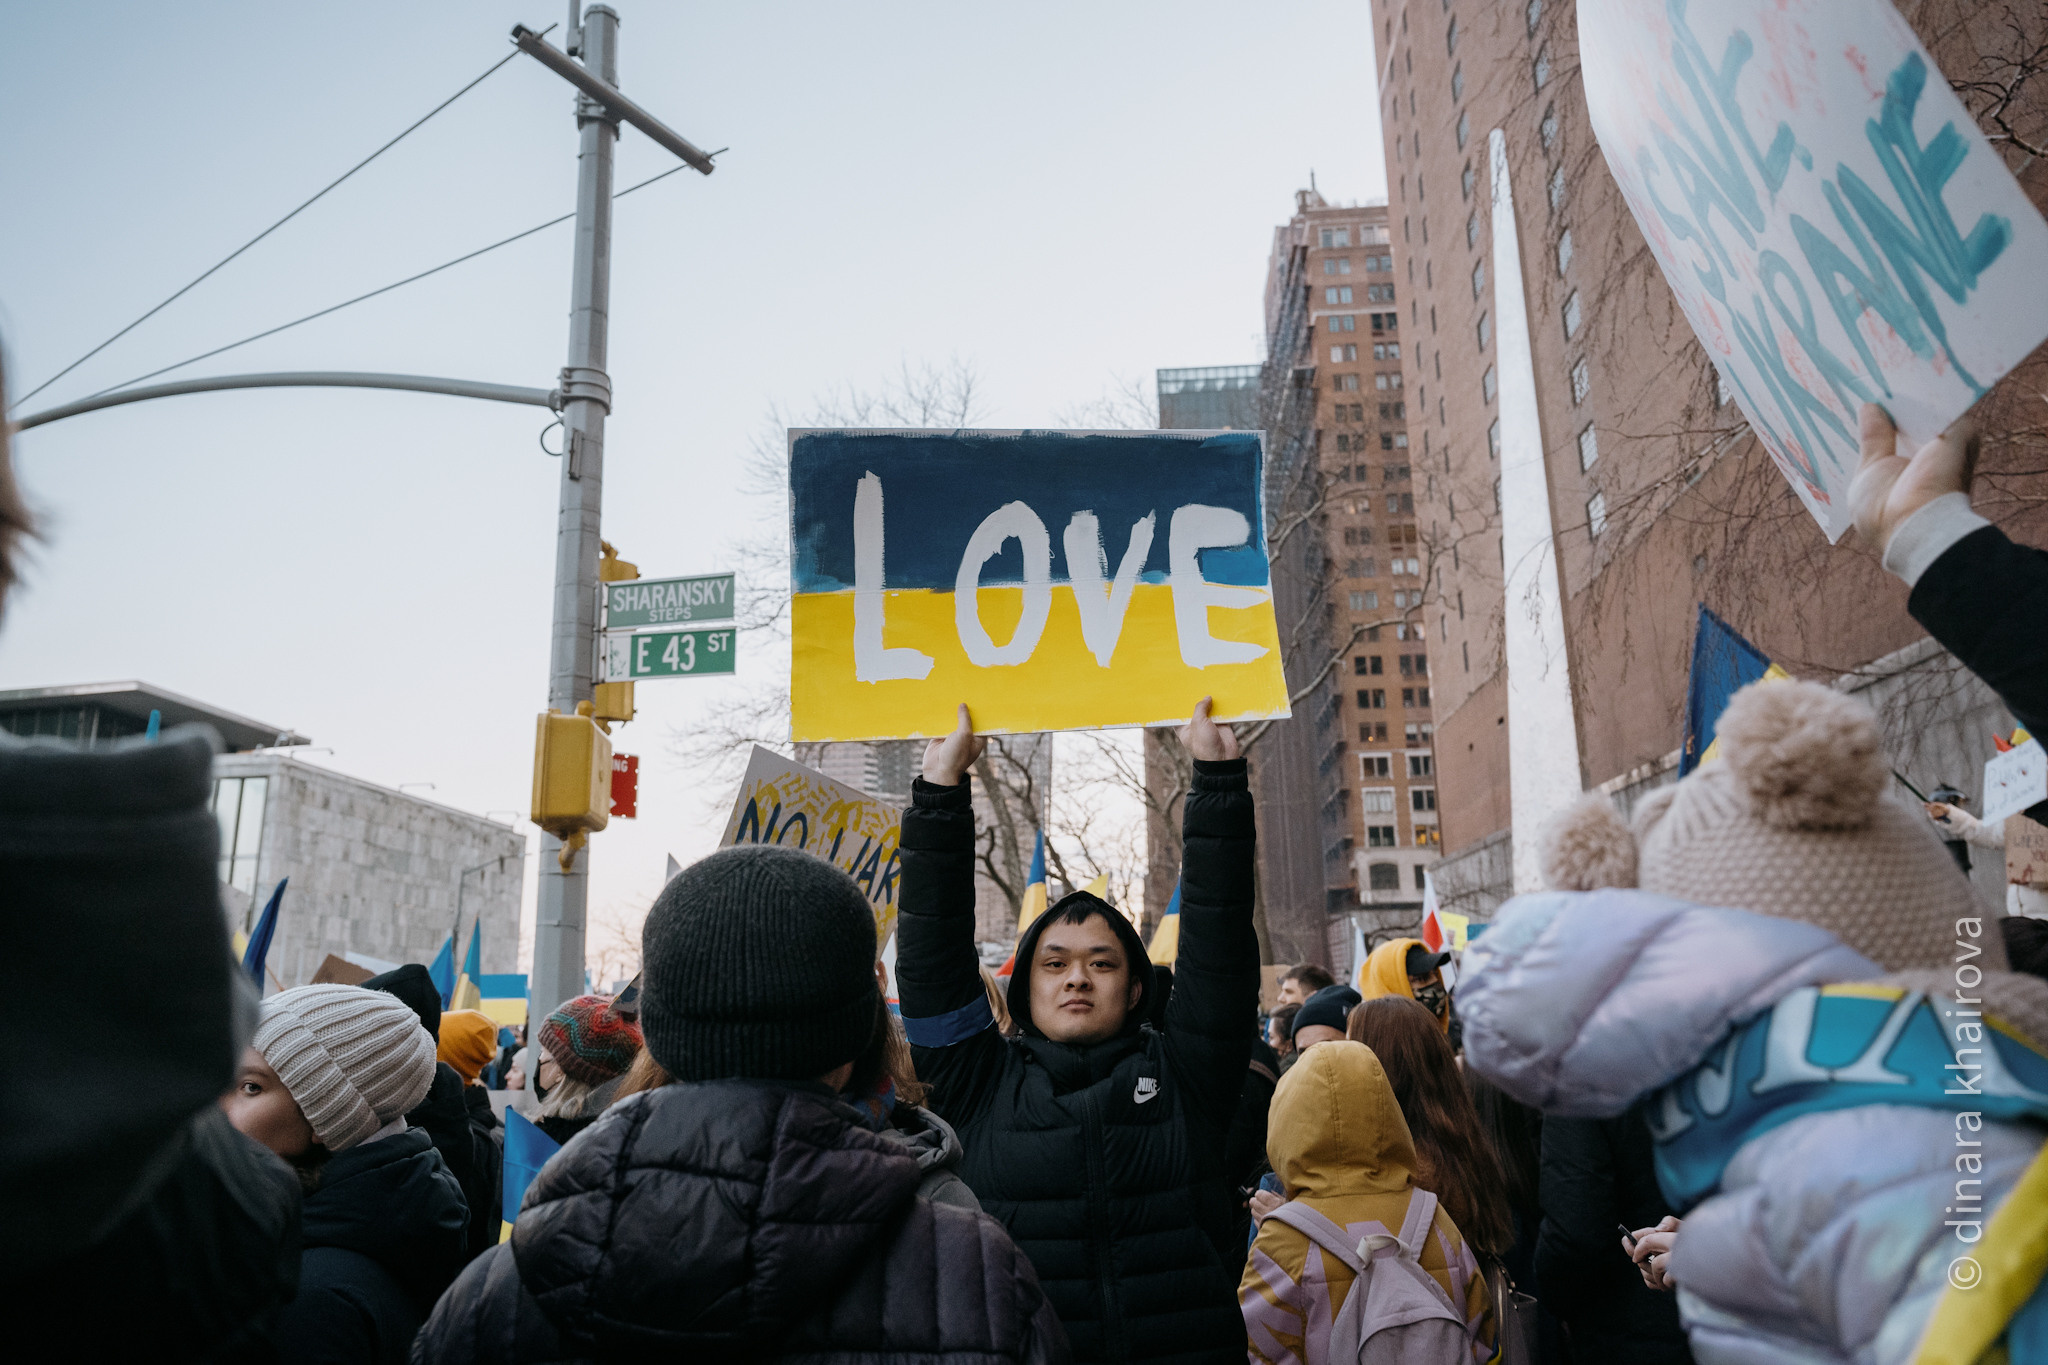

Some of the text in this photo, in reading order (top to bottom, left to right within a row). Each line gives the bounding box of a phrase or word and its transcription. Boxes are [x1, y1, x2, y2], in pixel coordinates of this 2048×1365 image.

[853, 470, 1271, 684] LOVE
[613, 580, 730, 612] SHARANSKY
[649, 607, 692, 622] STEPS
[637, 637, 652, 673] E
[662, 634, 696, 671] 43
[707, 633, 730, 653] ST
